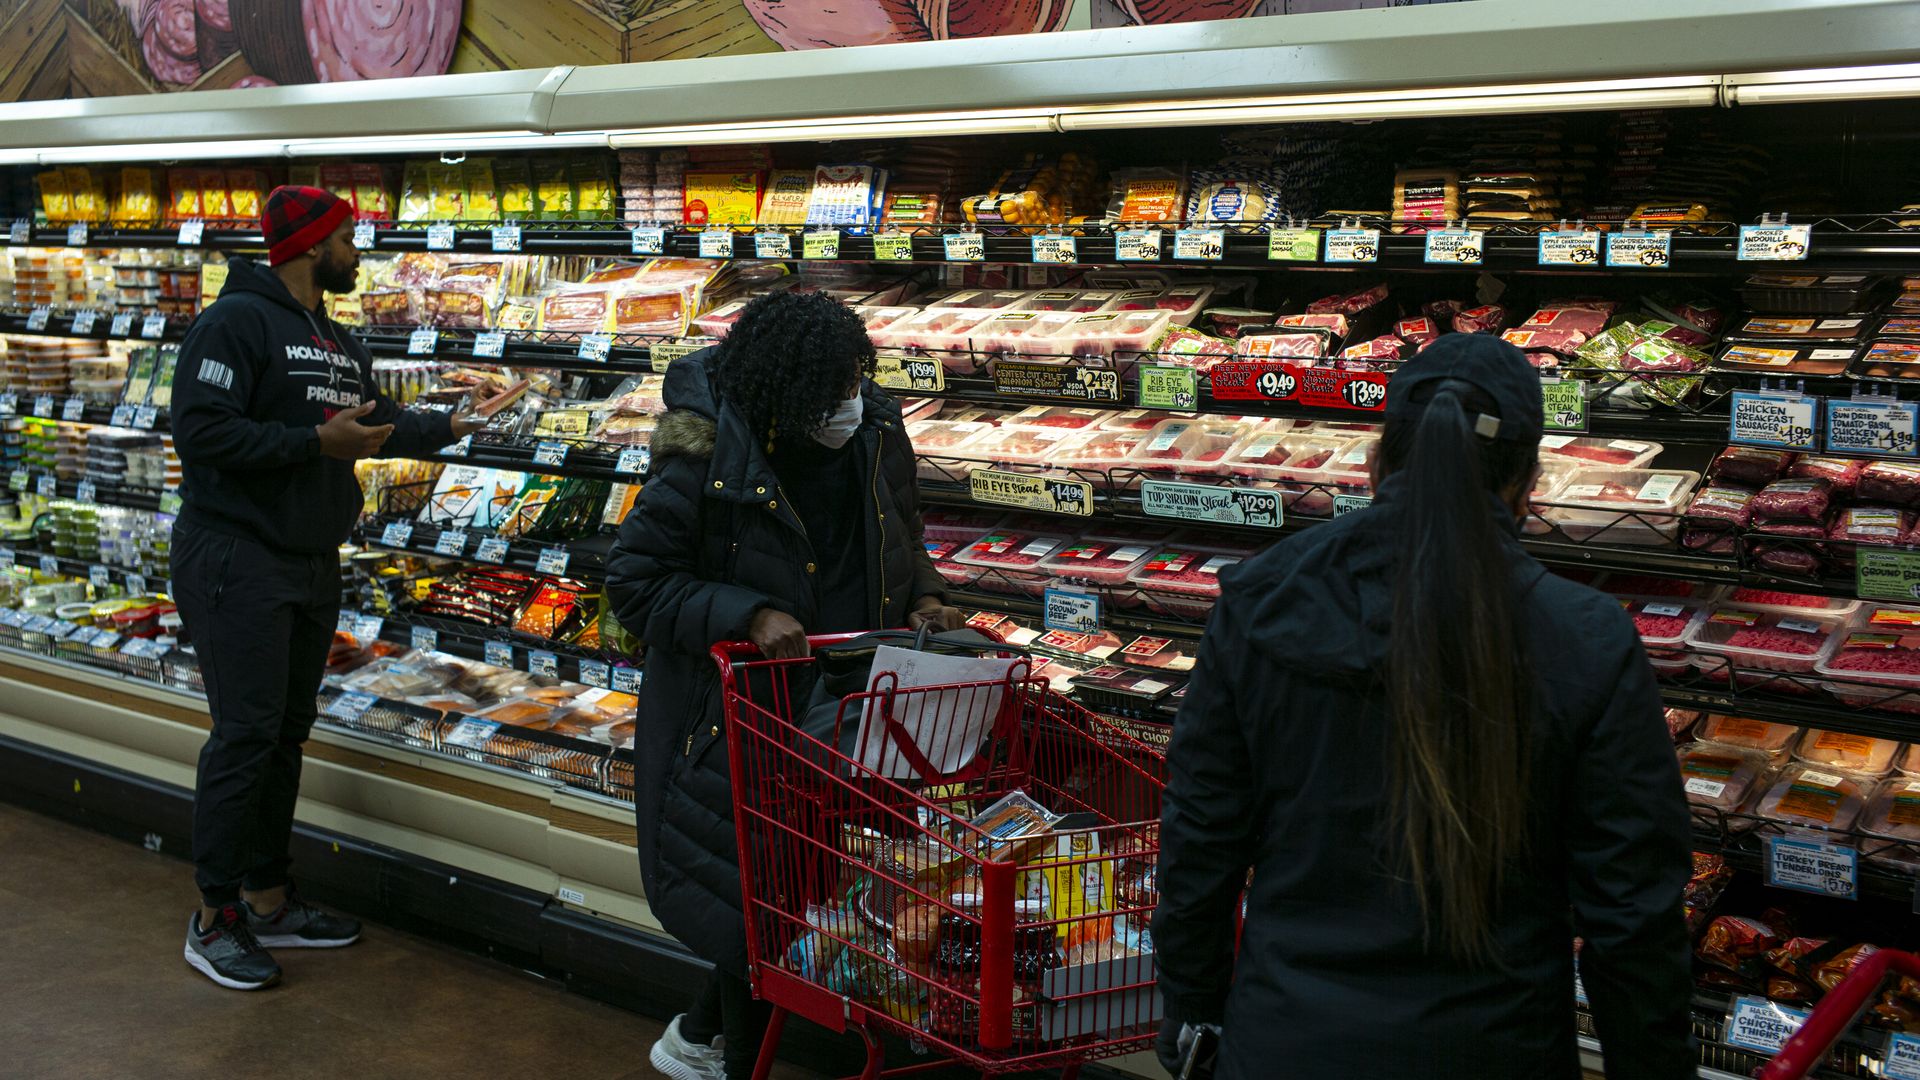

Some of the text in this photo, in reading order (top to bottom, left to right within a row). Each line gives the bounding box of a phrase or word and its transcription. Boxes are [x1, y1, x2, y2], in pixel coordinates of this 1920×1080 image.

[1744, 235, 1789, 243] ANDOUILLE
[285, 345, 324, 362] HOLD
[1214, 364, 1284, 372] BEEF NEW YORK
[1305, 368, 1354, 379] BEEF FILET
[996, 370, 1024, 379] CENTER
[1041, 372, 1068, 381] FILET
[1222, 371, 1251, 380] STRIP
[1303, 375, 1336, 385] MIGNON
[999, 377, 1034, 387] MIGNON
[1067, 382, 1084, 390] USDA
[1151, 376, 1182, 387] RIB EYE
[1256, 372, 1296, 395] $9.49
[306, 385, 361, 408] PROBLEMS
[1063, 388, 1086, 396] CHOICE
[1342, 380, 1386, 405] $13.99
[1542, 393, 1578, 403] SIRLOIN
[1548, 403, 1574, 411] STEAK
[1737, 403, 1786, 415] CHICKEN
[1736, 412, 1795, 424] BREAKFAST
[1833, 411, 1850, 419] SUN
[1852, 412, 1877, 420] DRIED
[1736, 421, 1779, 432] SAUSAGES
[1833, 419, 1893, 430] TOMATO-BASIL
[1832, 428, 1879, 437] CHICKEN
[1832, 436, 1874, 445] SAUSAGE
[980, 472, 1001, 480] PREMIUM
[973, 478, 1042, 495] RIB EYE Steak
[1147, 491, 1234, 511] TOP SIRLOIN Steak
[1861, 566, 1902, 577] GROUND
[1048, 604, 1078, 615] GROUND
[1048, 611, 1068, 621] BEEF
[1142, 731, 1170, 745] CHOP
[1775, 852, 1853, 873] TURKEY BREAST
[1775, 860, 1842, 879] TENDERLOINS
[1738, 1016, 1794, 1035] CHICKEN
[1740, 1026, 1780, 1041] THIGHS
